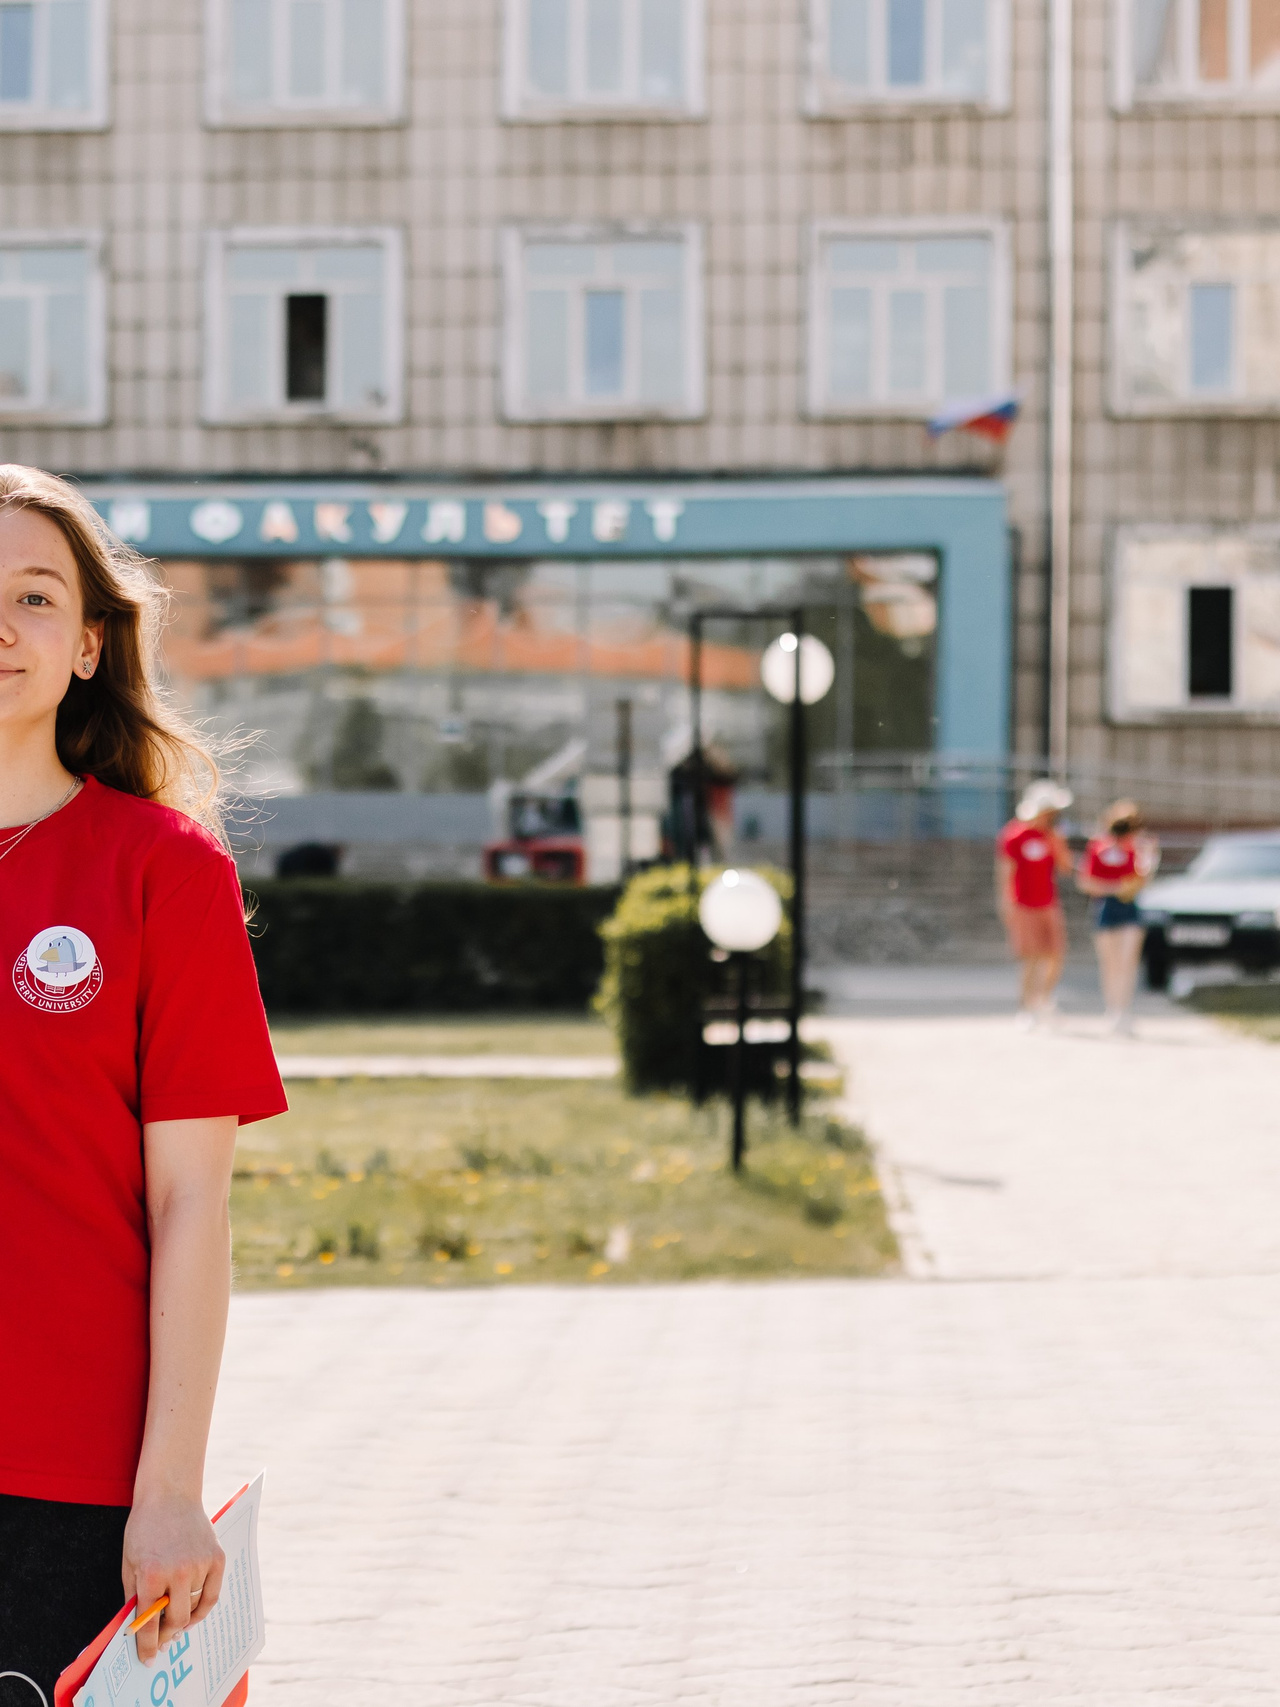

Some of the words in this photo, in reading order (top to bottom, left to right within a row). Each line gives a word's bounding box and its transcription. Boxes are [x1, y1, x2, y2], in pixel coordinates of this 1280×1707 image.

[190, 500, 685, 545] ФАКУЛЬТЕТ
[17, 980, 37, 1002] PERM
[38, 988, 93, 1010] UNIVERSITY
